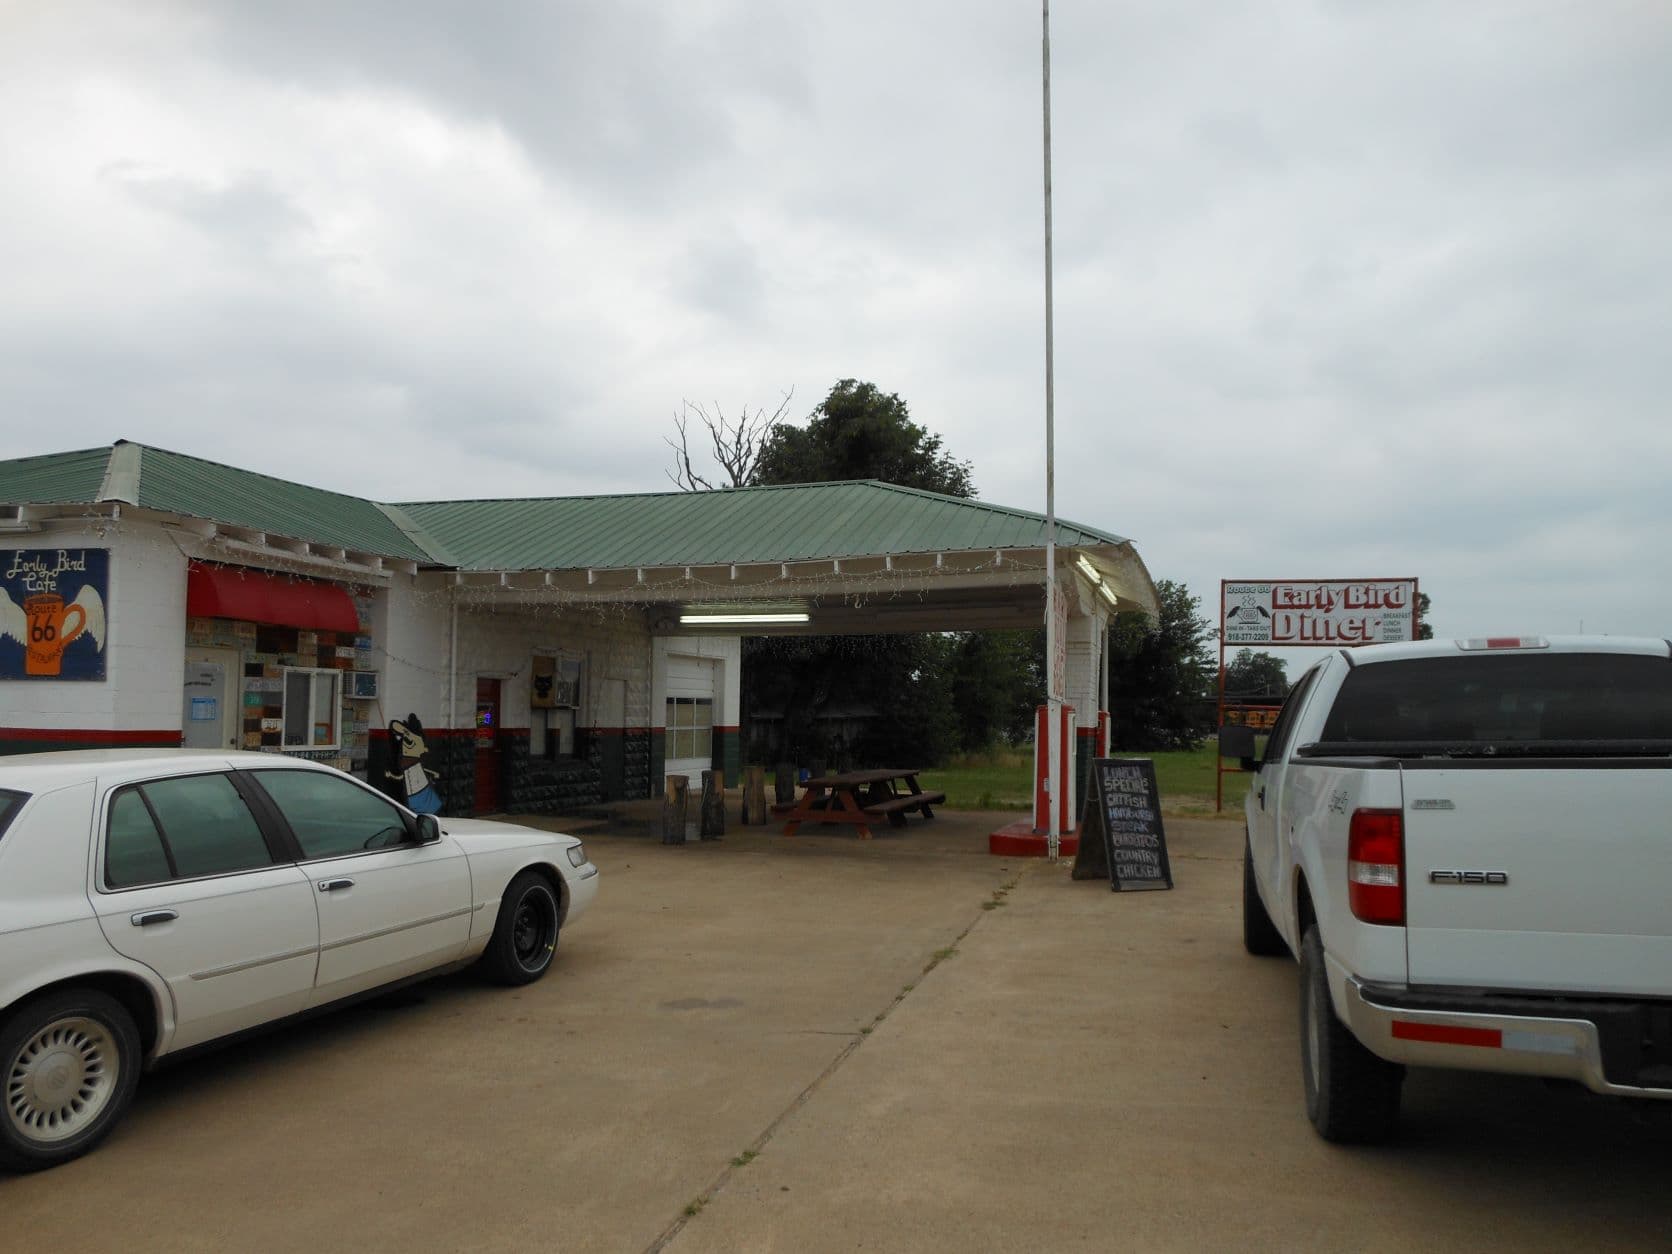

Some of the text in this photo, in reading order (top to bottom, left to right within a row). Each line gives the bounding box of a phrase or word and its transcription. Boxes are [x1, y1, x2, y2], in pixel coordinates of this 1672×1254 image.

[6, 550, 86, 578] Early Bird
[22, 572, 57, 593] Cafe
[1227, 585, 1270, 594] Route 66
[1272, 584, 1407, 614] Early Bird
[31, 614, 56, 642] 66
[1272, 611, 1383, 640] Diner
[1111, 821, 1149, 832] STEAK
[1114, 849, 1159, 864] COUNTRY
[1116, 864, 1161, 878] CHICKEN
[1430, 870, 1508, 884] F-150
